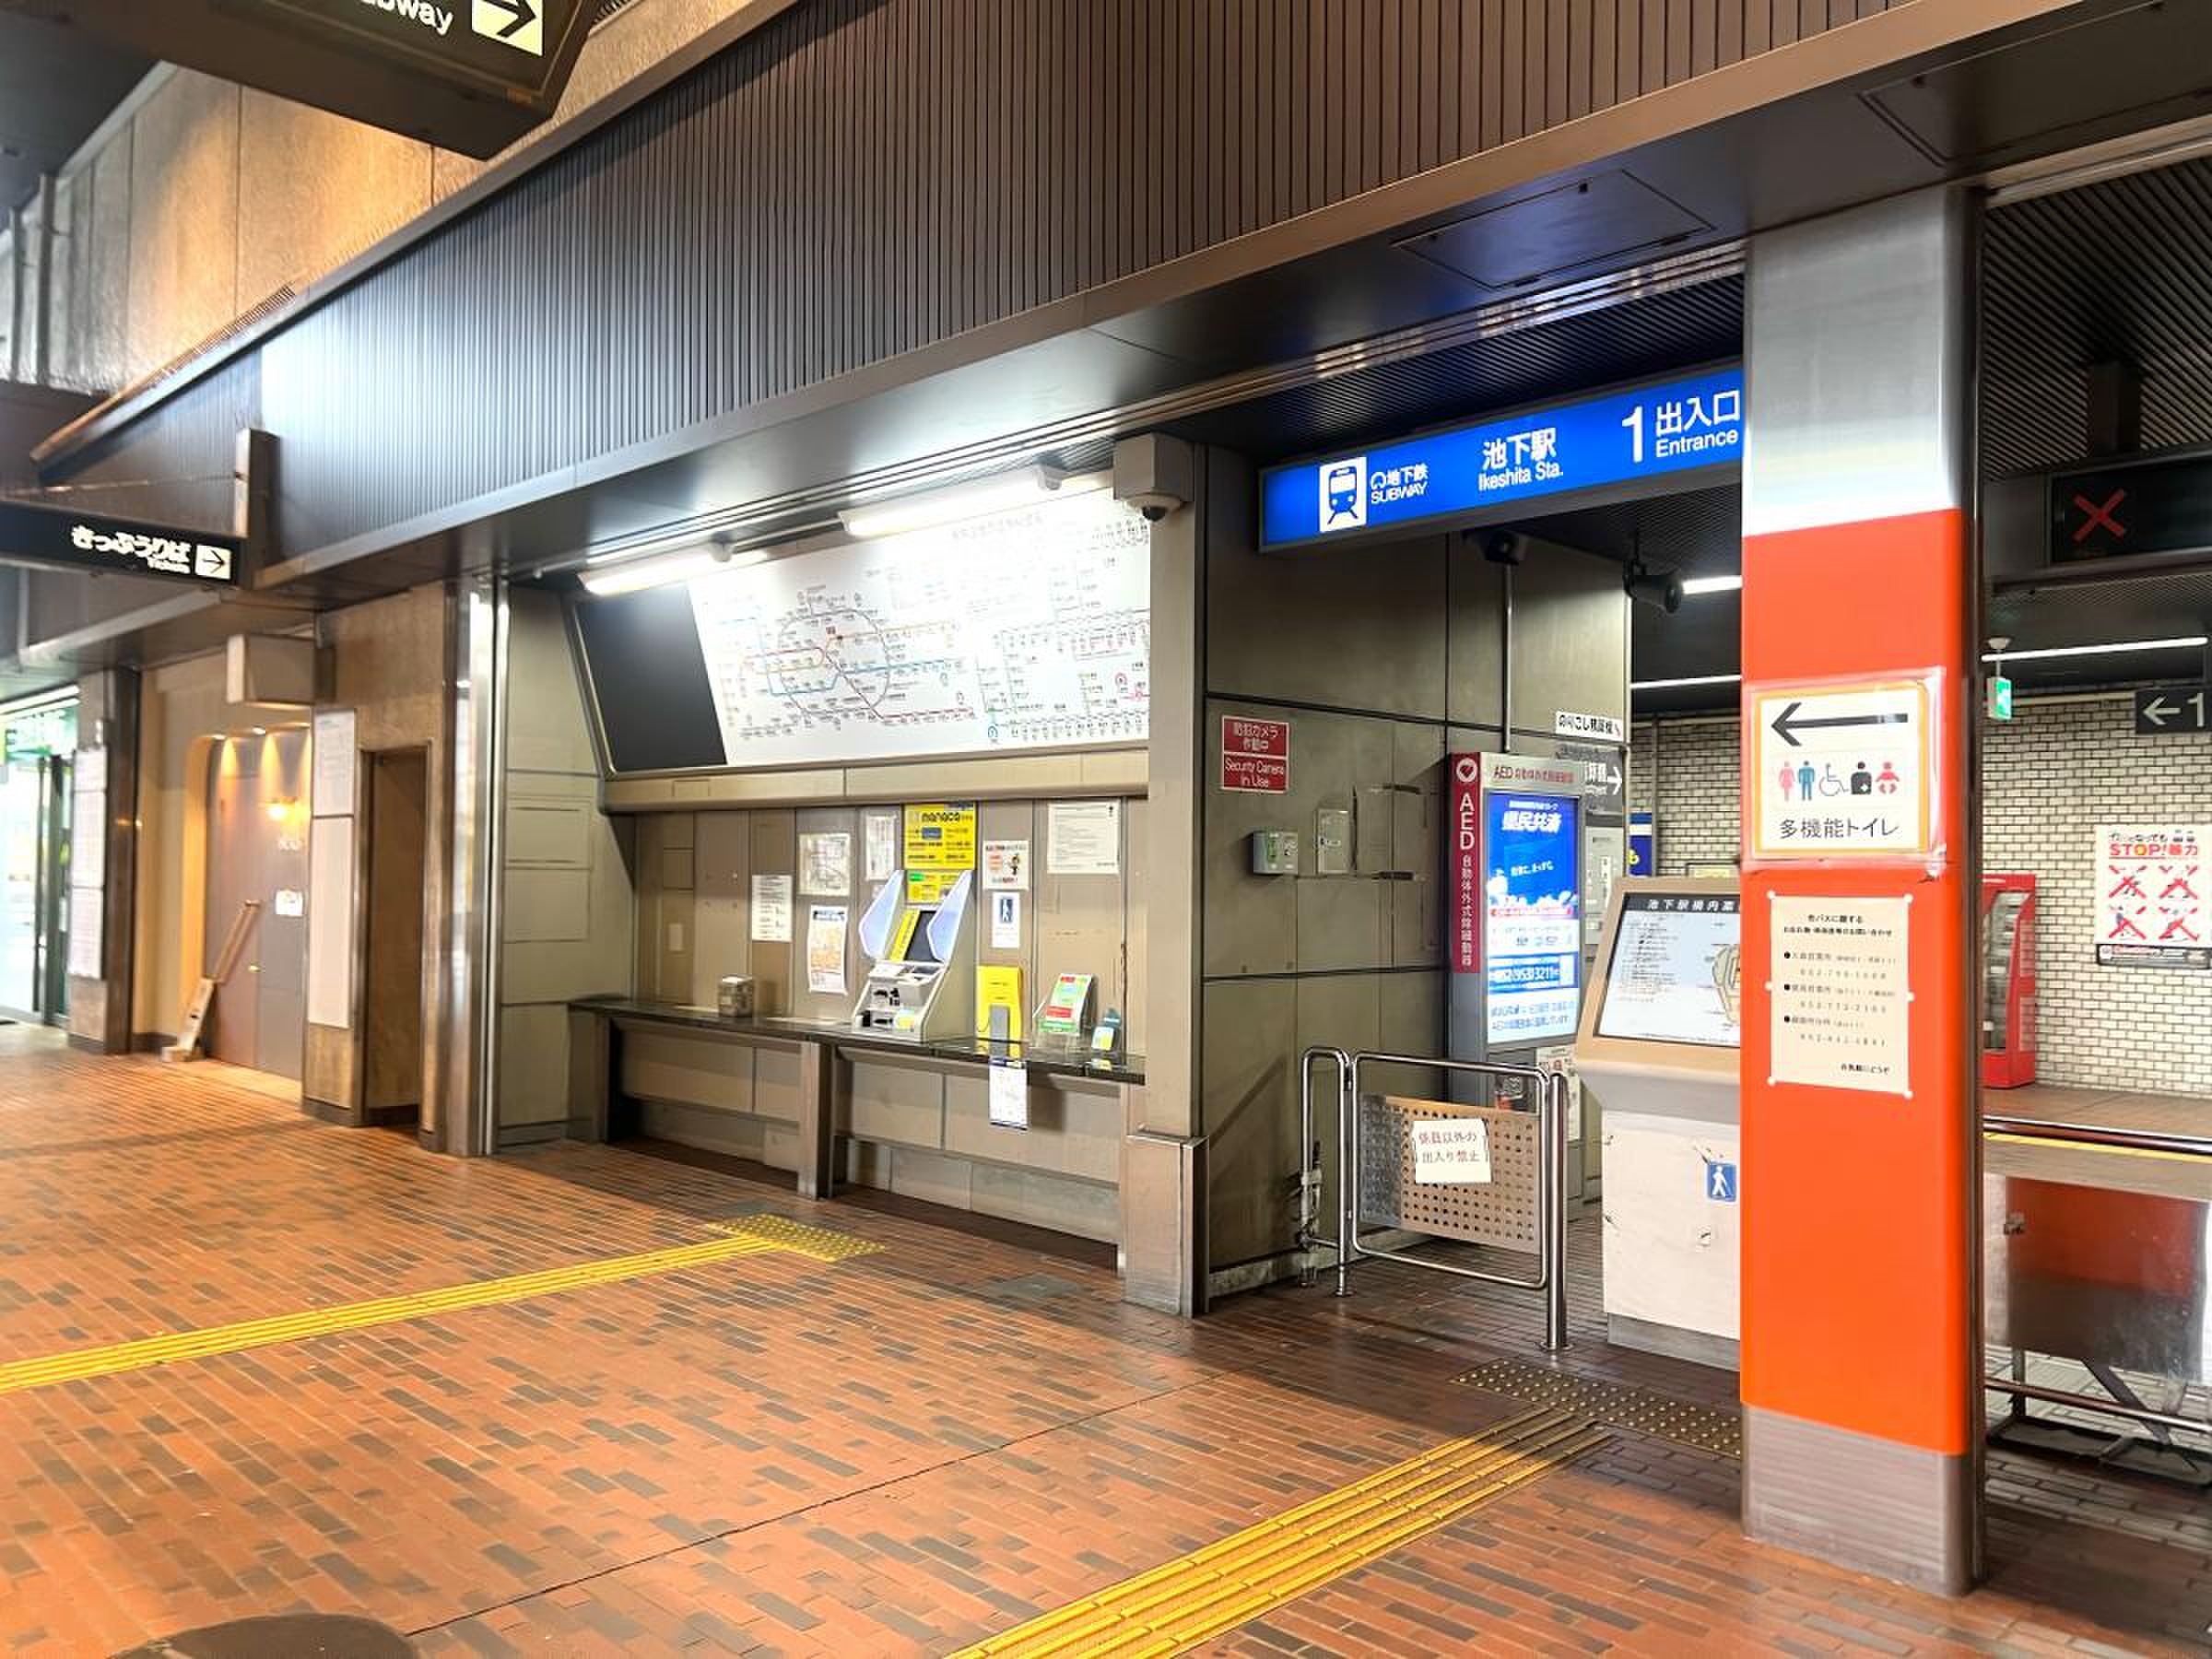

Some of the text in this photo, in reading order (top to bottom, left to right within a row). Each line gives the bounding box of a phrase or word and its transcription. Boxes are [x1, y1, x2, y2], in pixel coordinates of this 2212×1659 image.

[1656, 390, 1740, 437] 出入口
[1482, 428, 1557, 471] 池下駅
[1622, 406, 1643, 463] 1
[1656, 429, 1739, 458] Entrance
[1386, 463, 1428, 486] 地下鉄
[1478, 461, 1564, 491] Ikeshita Sta.
[1371, 481, 1428, 504] SUBWAY
[71, 525, 191, 563] きっぷうりば
[2187, 692, 2205, 727] 1
[1459, 793, 1476, 850] AED
[1781, 818, 1900, 839] 多機能トイレ
